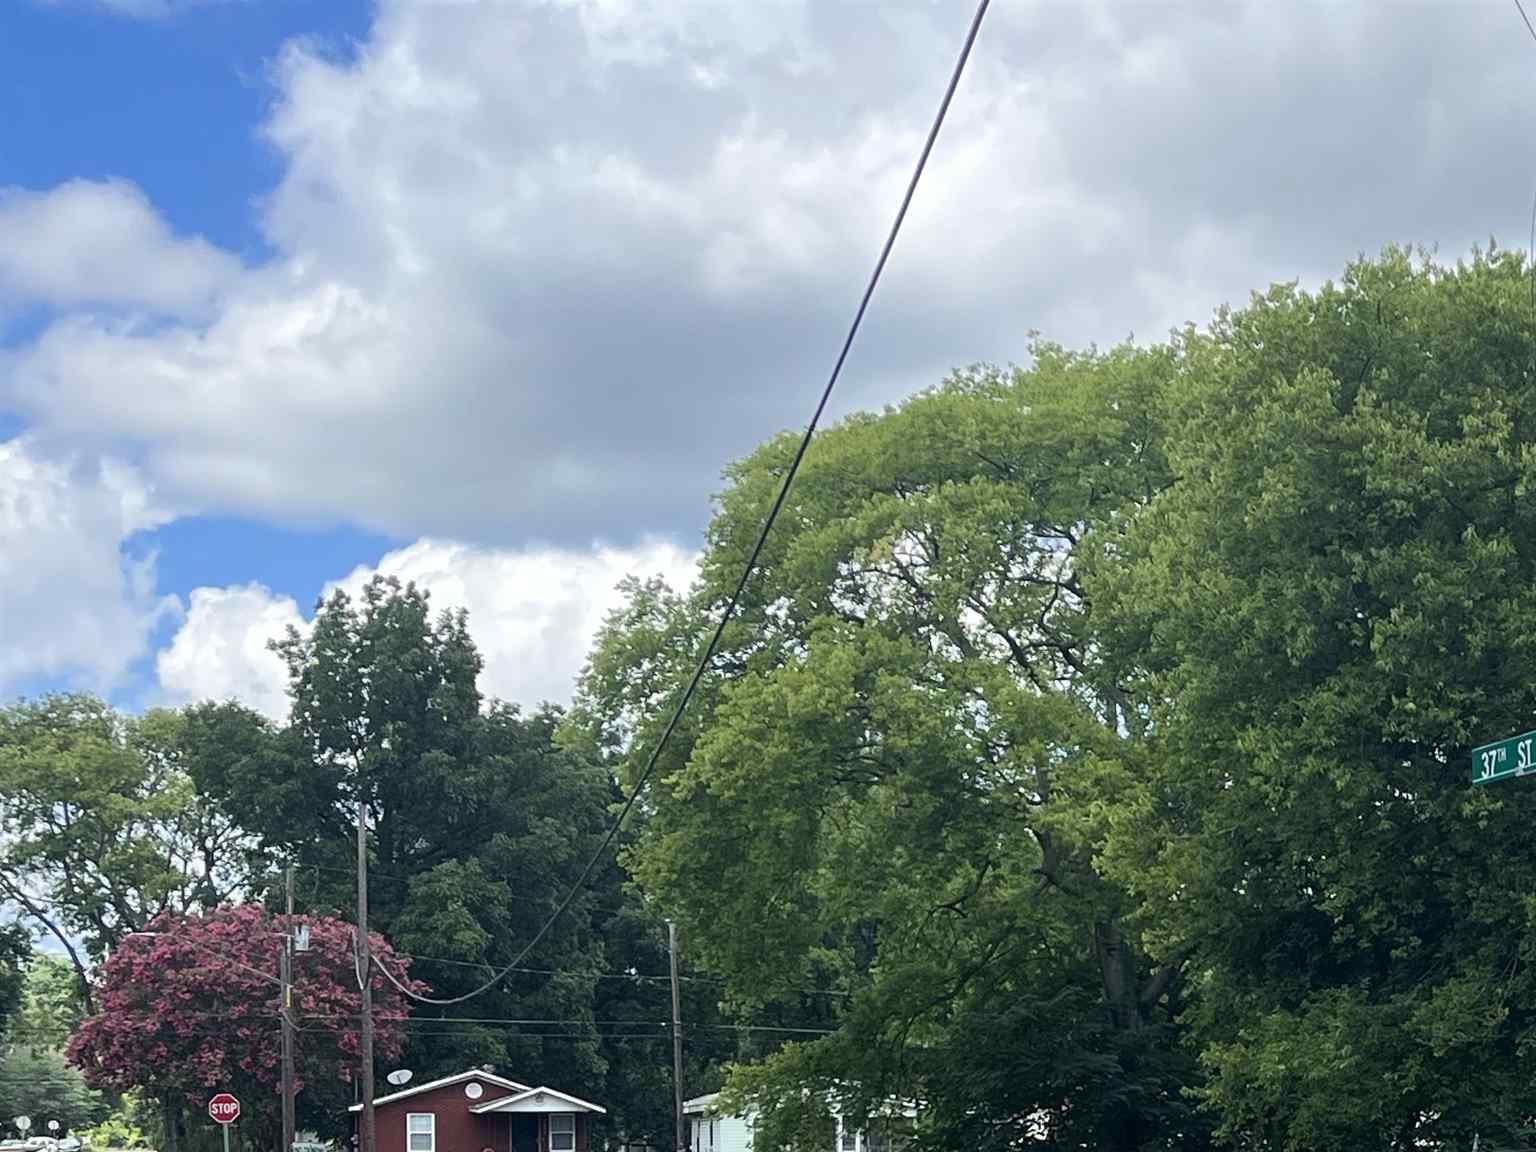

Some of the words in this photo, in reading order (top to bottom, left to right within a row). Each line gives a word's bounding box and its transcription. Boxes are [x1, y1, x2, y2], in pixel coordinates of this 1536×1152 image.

[1480, 748, 1507, 779] 37TH
[1517, 739, 1533, 769] ST
[211, 1102, 237, 1114] STOP
